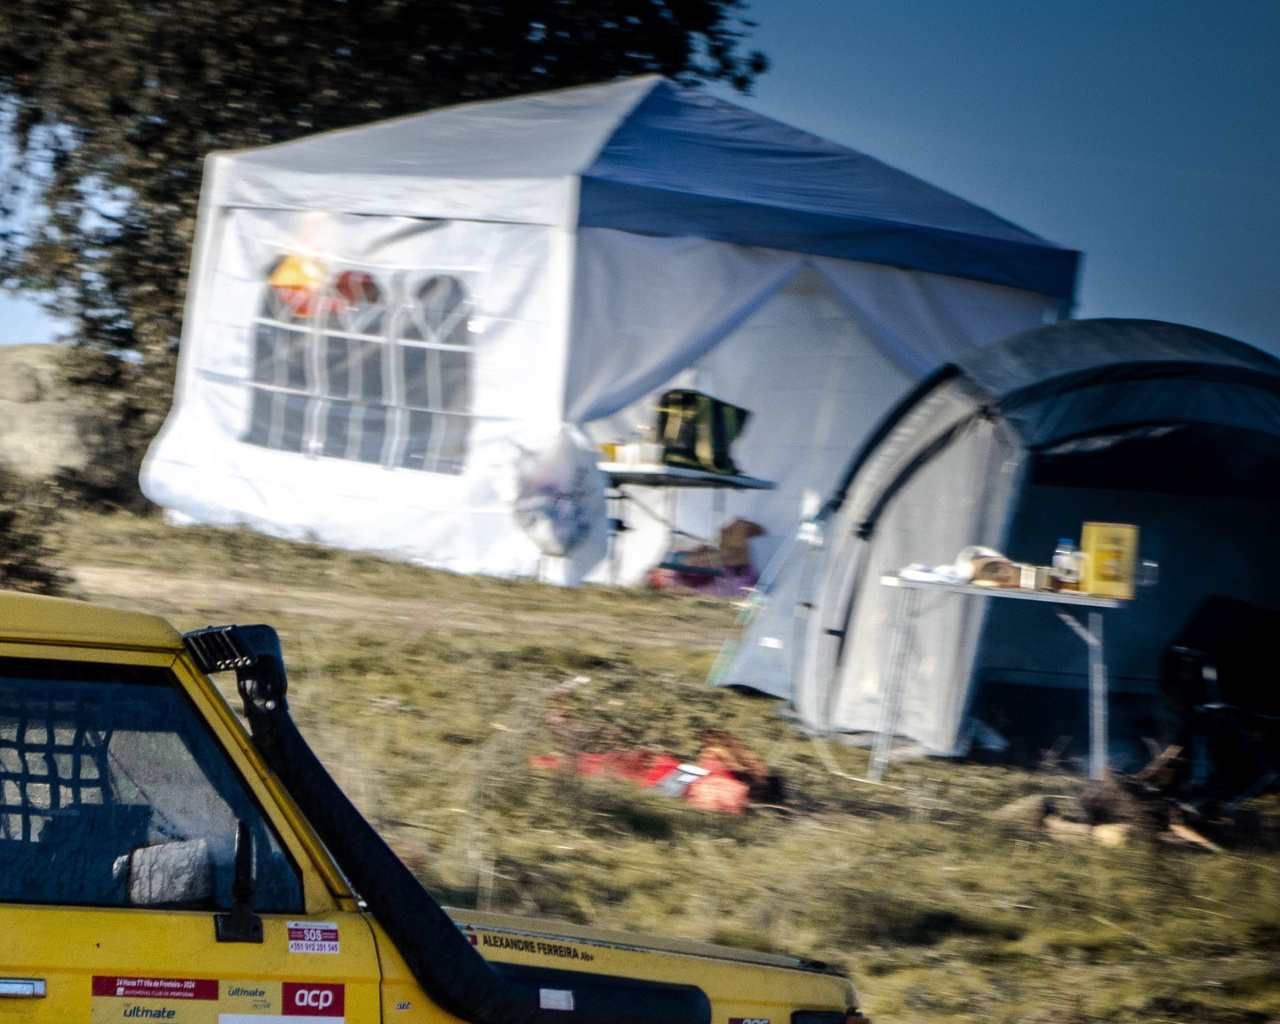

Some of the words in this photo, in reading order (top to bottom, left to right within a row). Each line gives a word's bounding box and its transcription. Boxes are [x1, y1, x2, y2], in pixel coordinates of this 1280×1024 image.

[303, 929, 322, 941] SOS
[482, 934, 536, 953] ALEXANDRE
[537, 942, 580, 960] FERREIRA
[123, 979, 137, 987] Horas
[144, 979, 153, 987] Vila
[153, 980, 160, 988] de
[160, 980, 181, 988] Fronteira
[228, 987, 266, 997] ultimate
[295, 989, 333, 1010] acp
[123, 1005, 176, 1019] ultimate
